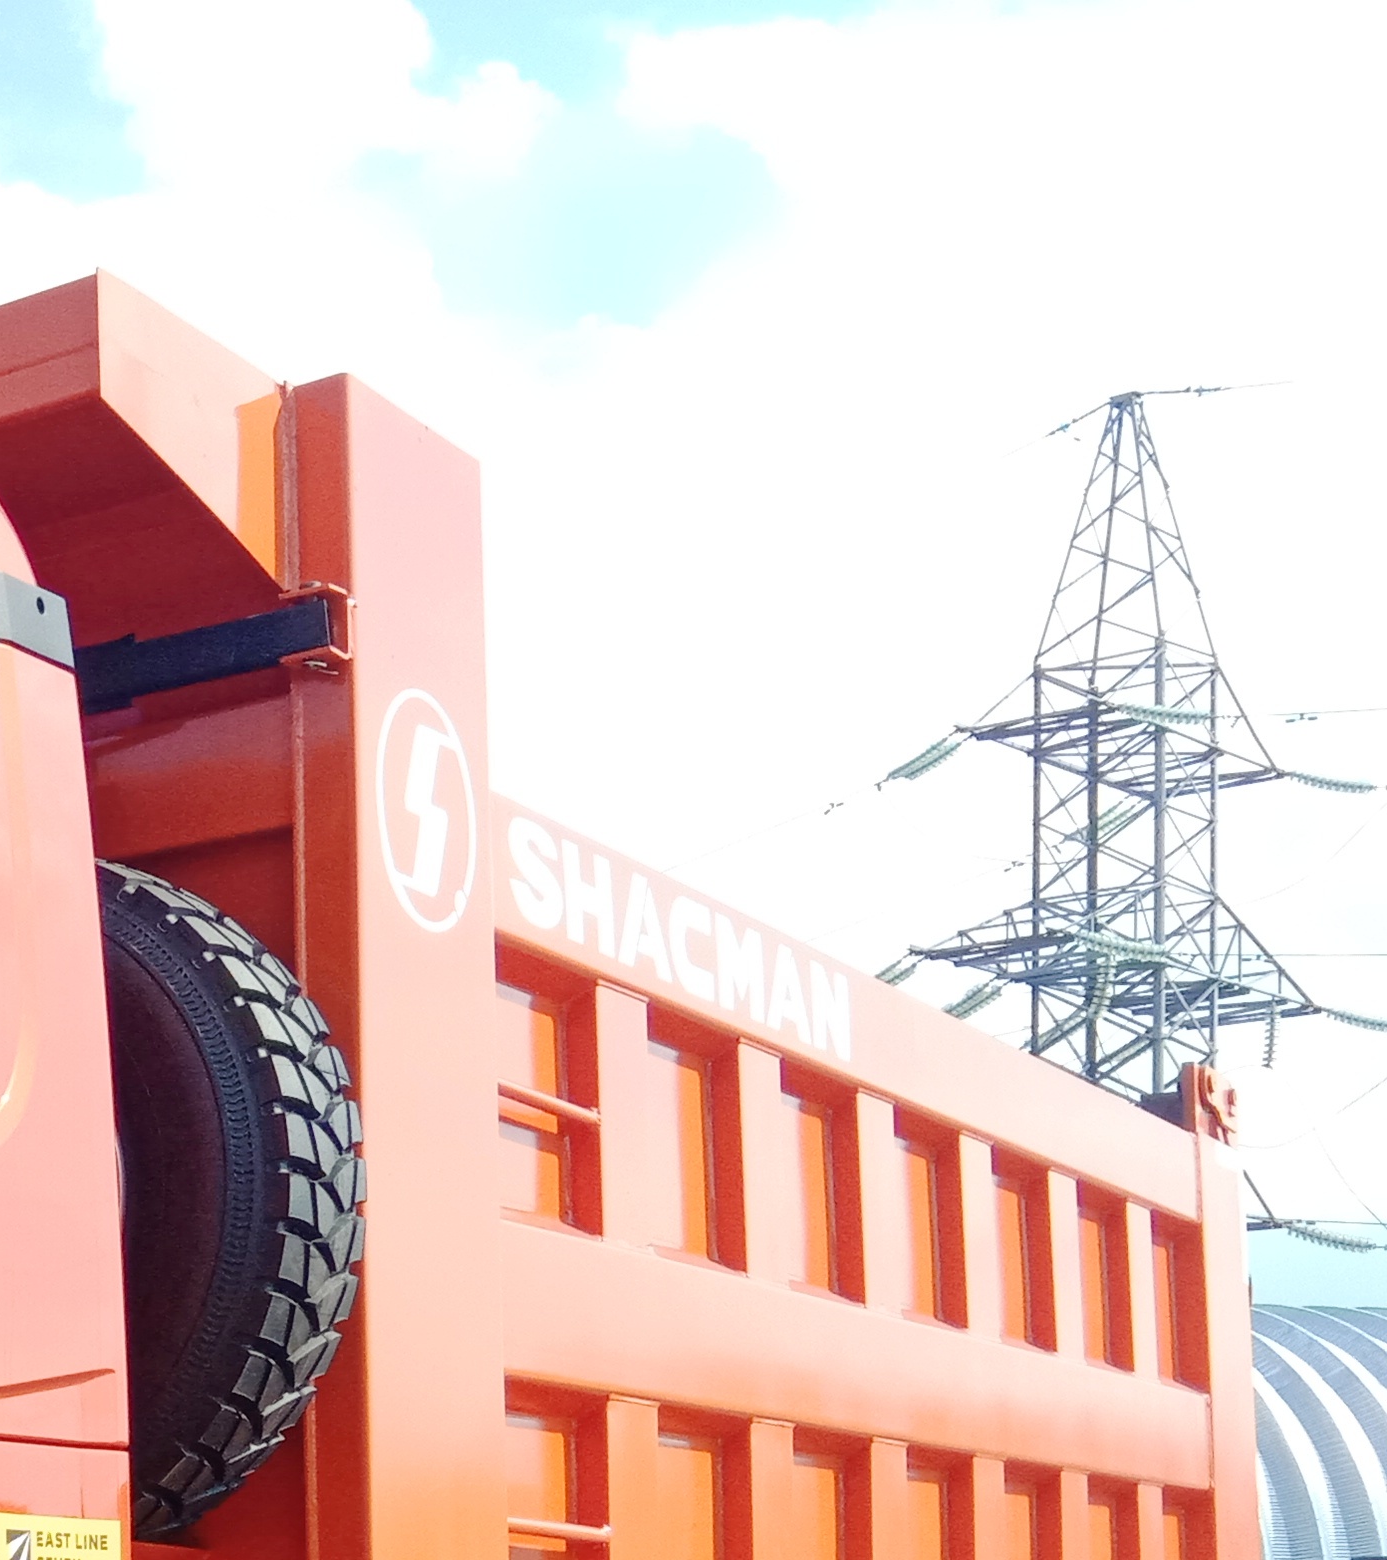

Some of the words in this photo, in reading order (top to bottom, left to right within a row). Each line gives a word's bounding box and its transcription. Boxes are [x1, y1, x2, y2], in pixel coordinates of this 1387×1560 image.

[507, 815, 852, 1063] SHACMAN
[36, 1531, 71, 1549] EAST
[75, 1533, 108, 1551] LINE
